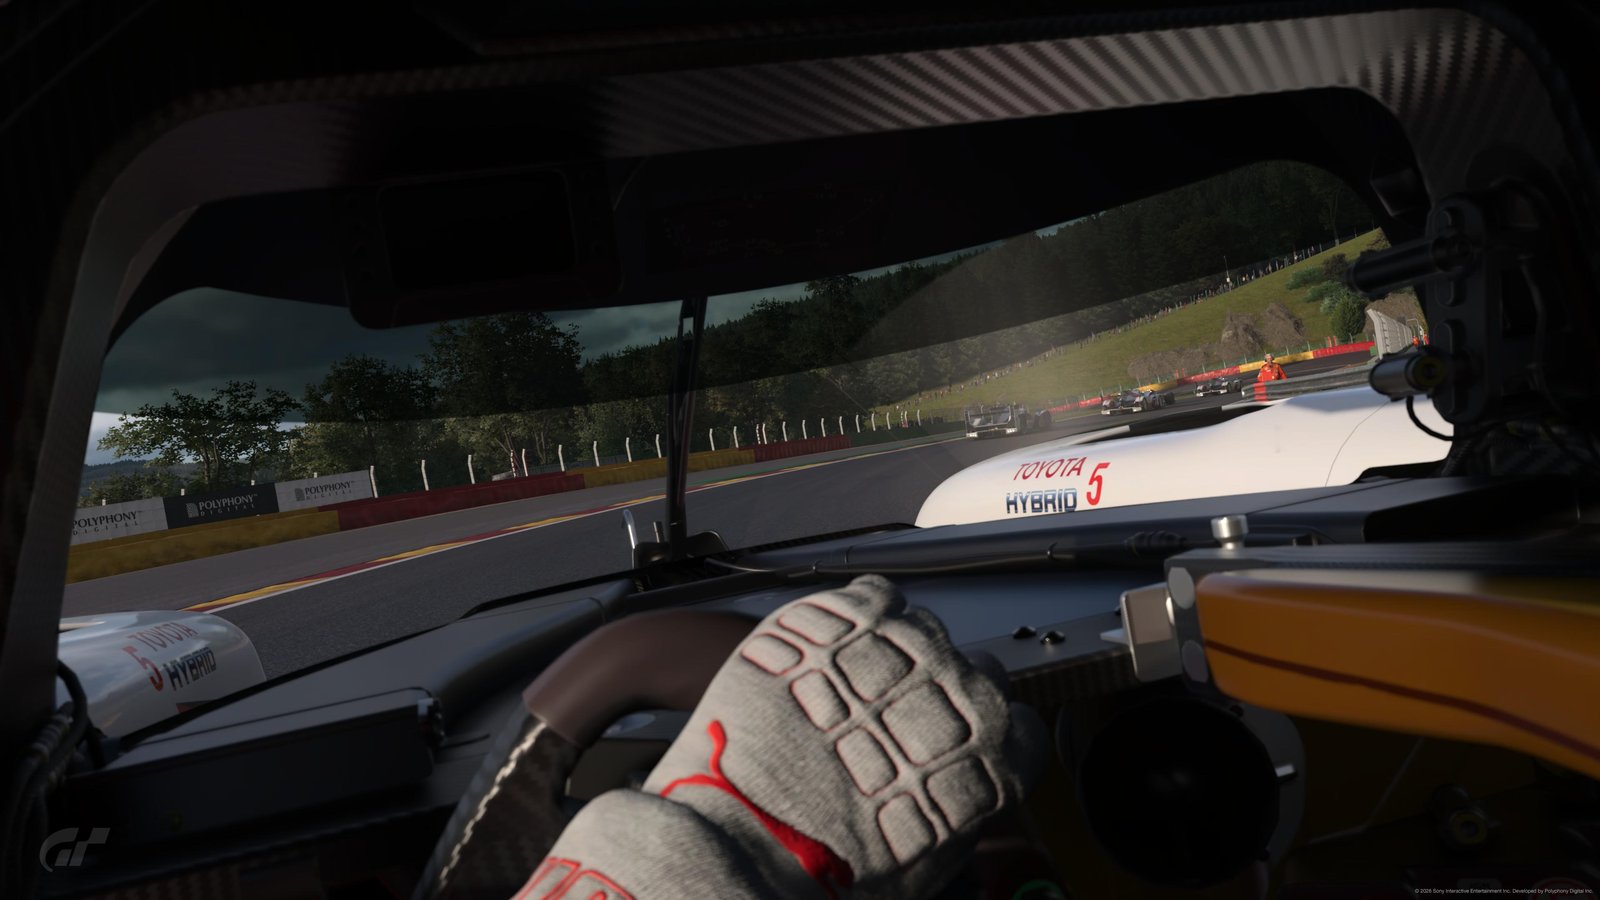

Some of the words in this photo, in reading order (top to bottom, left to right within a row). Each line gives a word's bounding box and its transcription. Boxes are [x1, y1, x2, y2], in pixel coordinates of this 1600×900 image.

[304, 480, 352, 496] POLYPHONY
[1013, 456, 1088, 481] TOYOTA
[1086, 461, 1111, 506] 5
[198, 494, 254, 511] POLYPHONY
[200, 503, 256, 517] DIGITAL
[1005, 487, 1078, 514] HYBRID
[71, 510, 138, 529] POLYPHONY
[72, 520, 139, 536] DIGITAL
[127, 621, 199, 652] TOYOTA
[122, 645, 165, 692] 5
[162, 646, 218, 691] HYBRID
